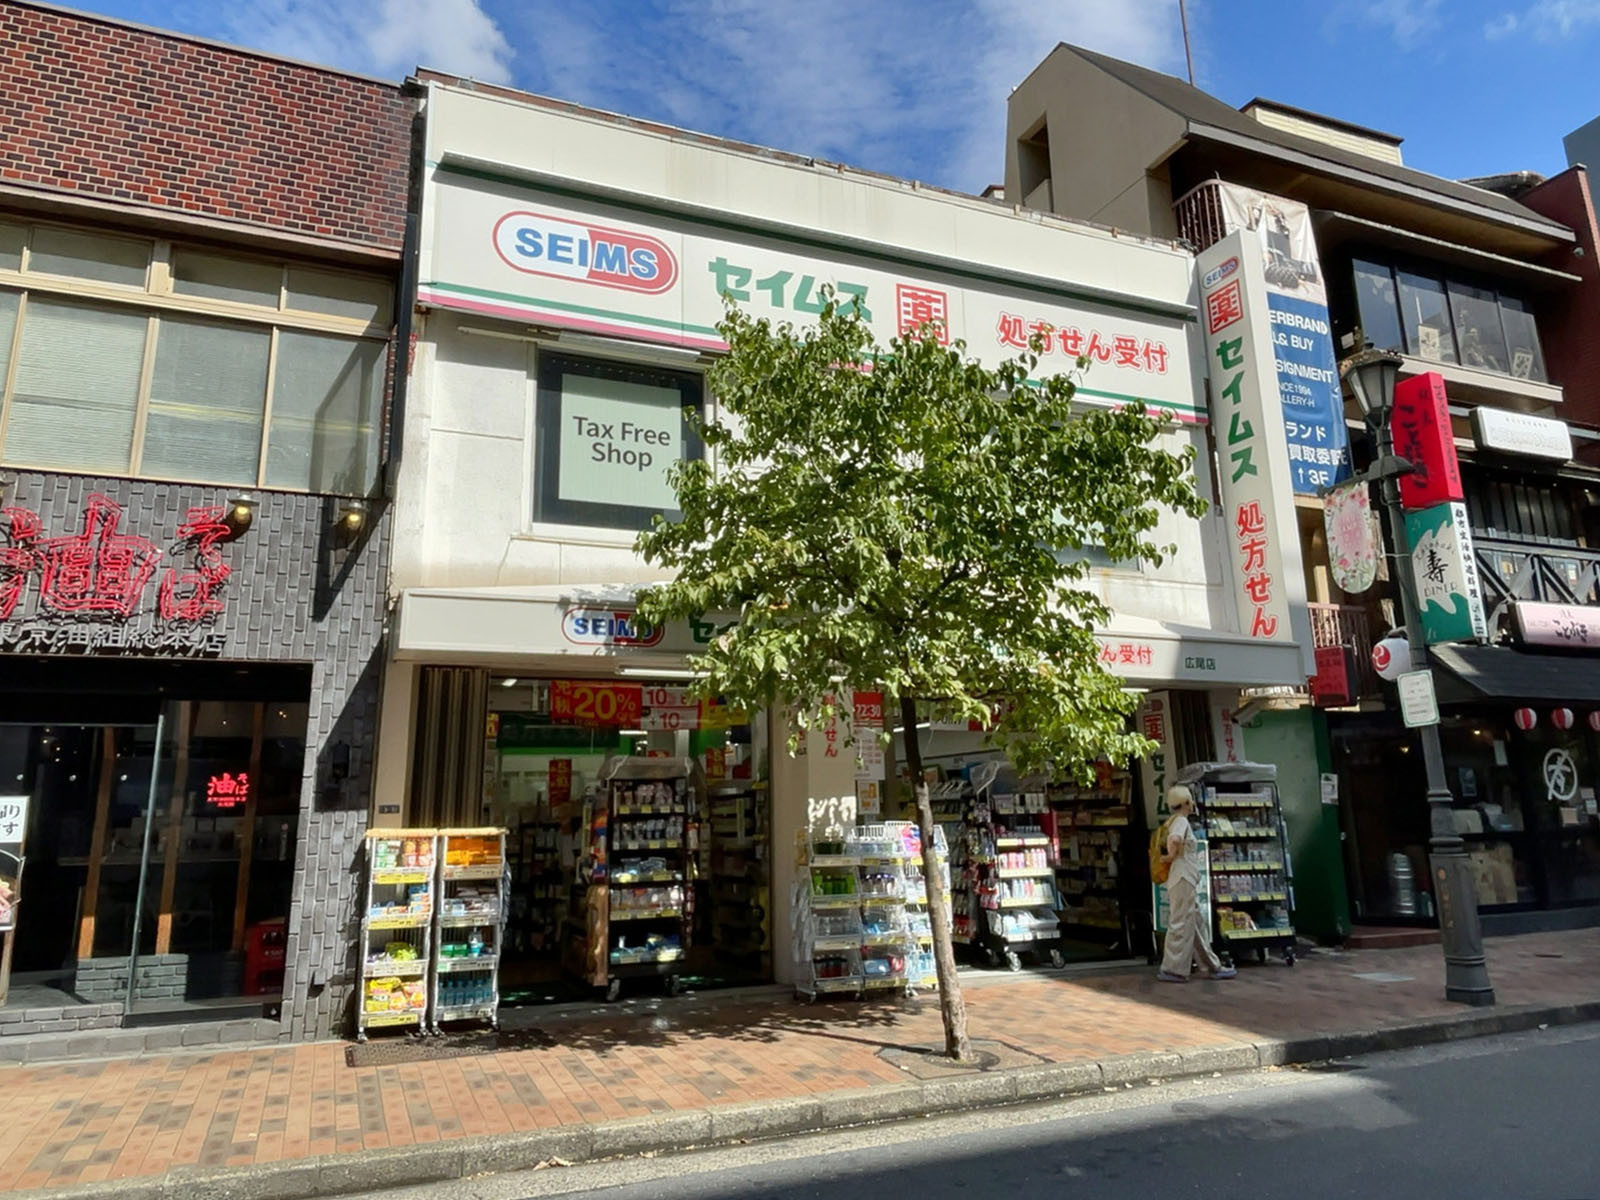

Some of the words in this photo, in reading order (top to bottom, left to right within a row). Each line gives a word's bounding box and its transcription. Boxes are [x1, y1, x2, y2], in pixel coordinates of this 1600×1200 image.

[515, 226, 659, 281] SEIMS
[708, 256, 872, 323] セイムス
[1205, 262, 1236, 286] SEIMS
[1207, 278, 1243, 335] 薬
[1269, 310, 1329, 335] ERBRAND
[998, 311, 1170, 374] 処方せん受付
[1290, 335, 1314, 351] BUY
[1275, 359, 1334, 384] SIGNMENT
[1215, 337, 1258, 484] セイムス
[573, 415, 616, 439] Tax
[620, 421, 672, 447] Free
[1286, 421, 1327, 442] ランド
[591, 442, 653, 472] Shop
[1308, 469, 1330, 486] 3F
[1237, 499, 1279, 638] 処方せん
[1422, 549, 1449, 584] 寿
[1150, 752, 1171, 826] セイム
